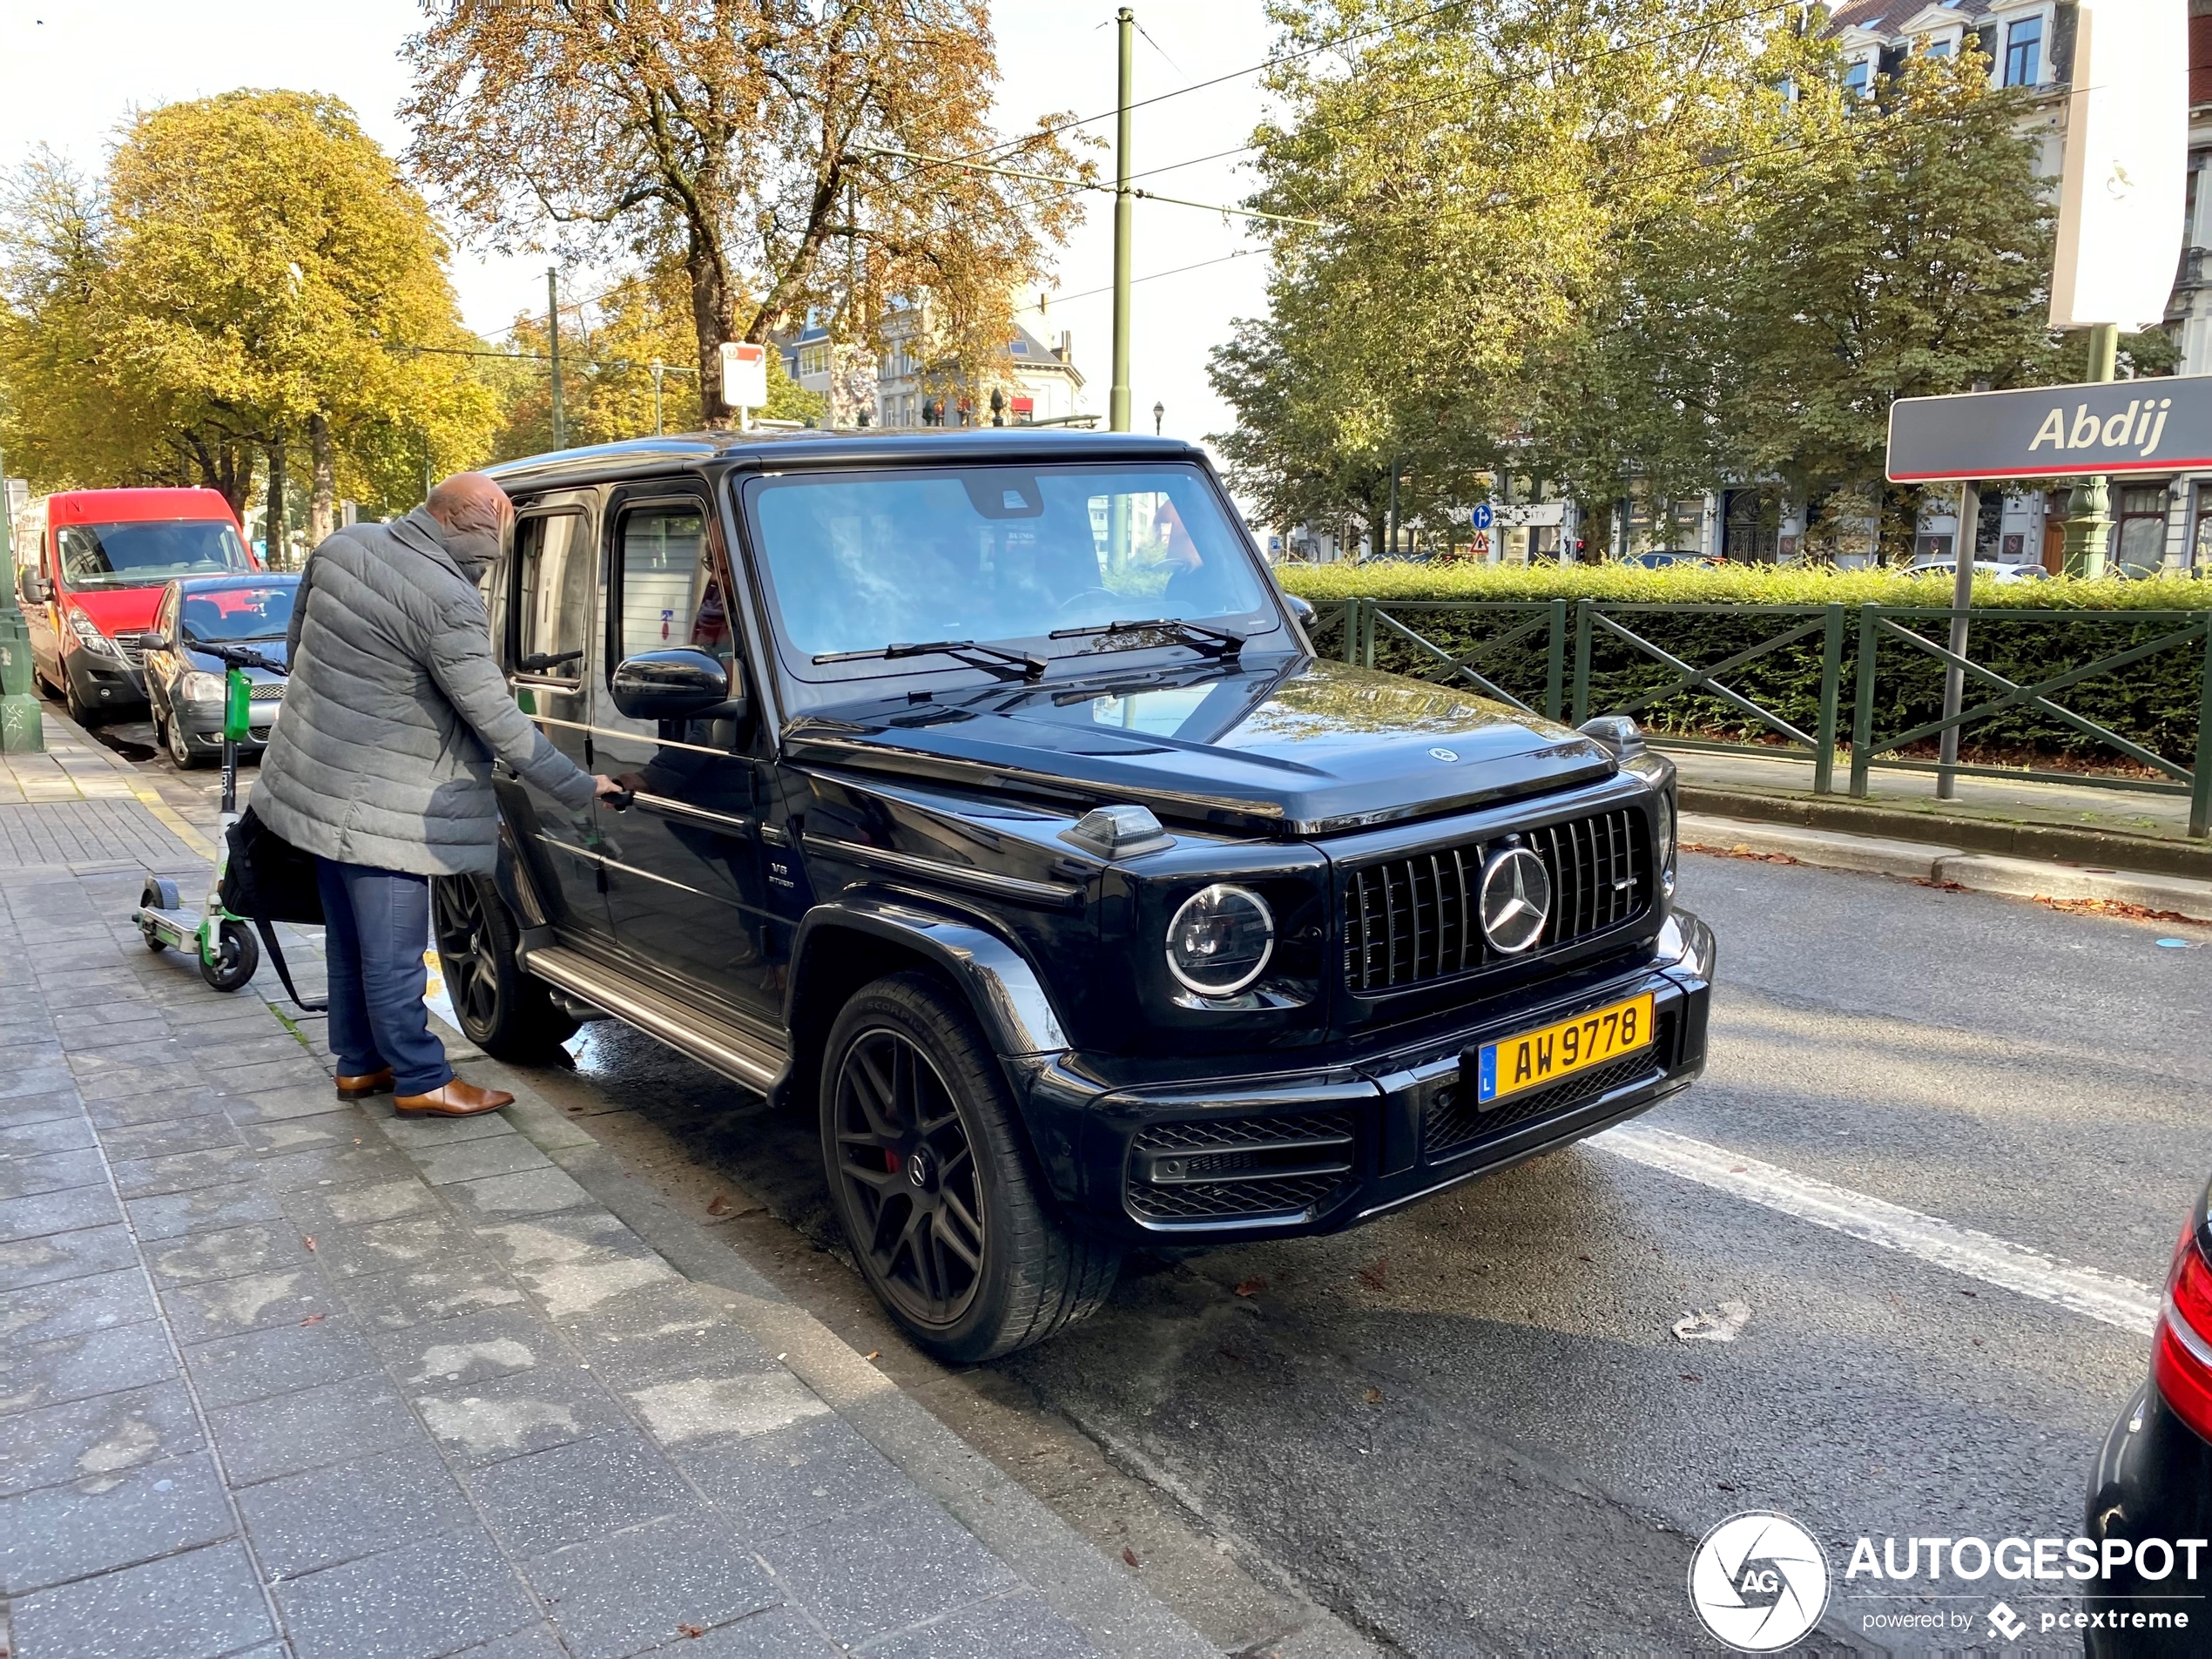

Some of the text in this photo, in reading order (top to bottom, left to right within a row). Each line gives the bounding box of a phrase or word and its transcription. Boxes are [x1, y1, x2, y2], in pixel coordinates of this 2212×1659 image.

[2028, 398, 2172, 456] Abdij
[769, 875, 794, 887] BITURBO
[772, 863, 787, 874] V8
[867, 1001, 934, 1044] SCORPION
[1514, 1008, 1636, 1083] AW 9778
[1483, 1078, 1490, 1091] L
